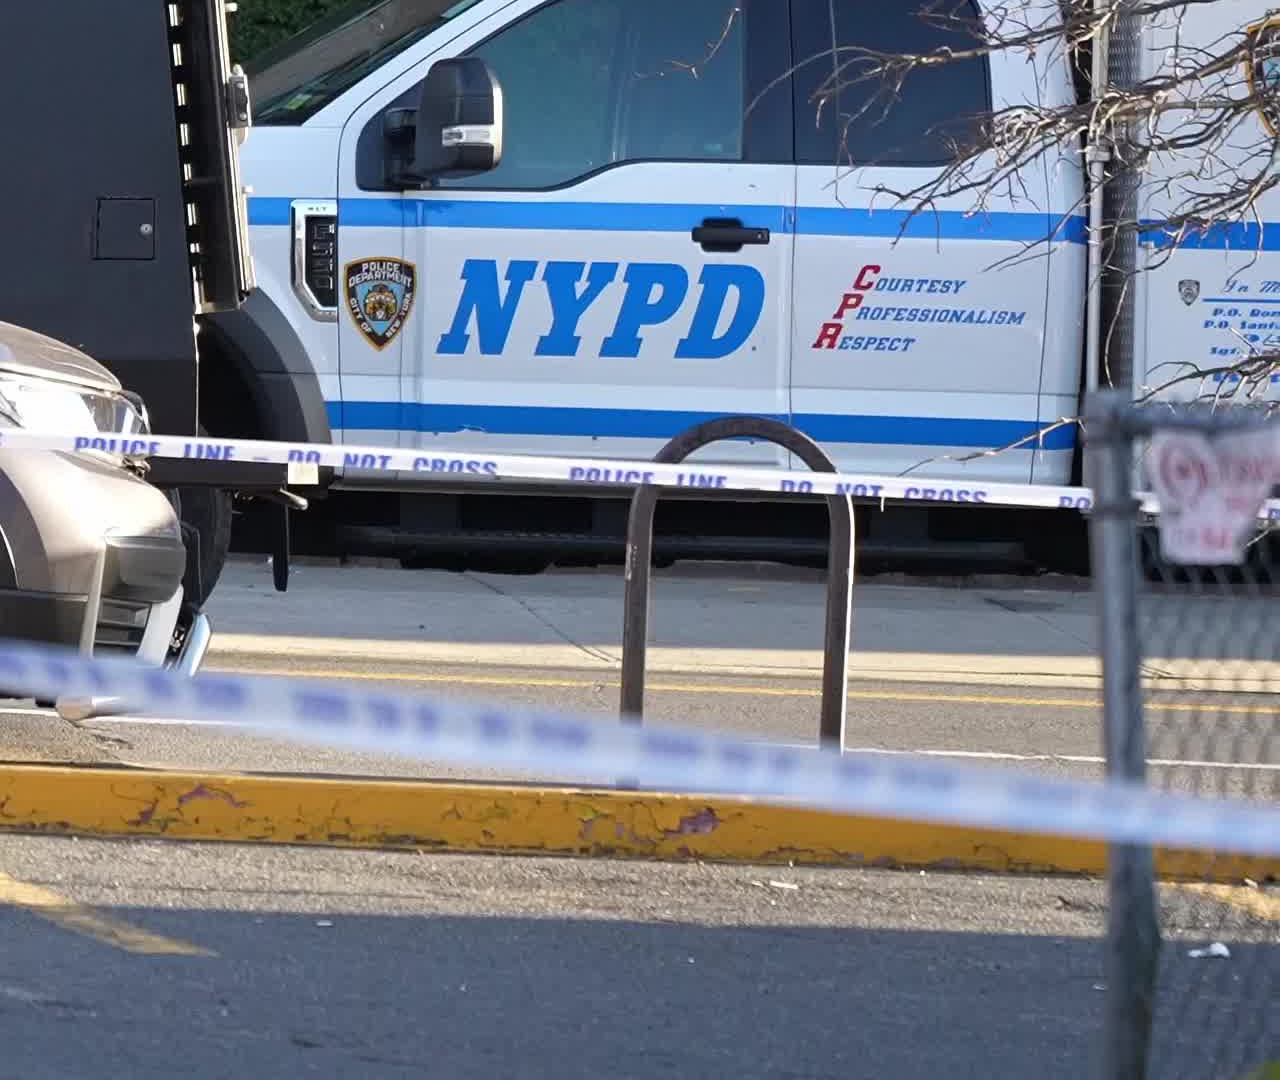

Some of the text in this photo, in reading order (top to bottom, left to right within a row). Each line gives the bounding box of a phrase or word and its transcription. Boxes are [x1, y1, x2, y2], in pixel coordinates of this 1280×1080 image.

[362, 262, 400, 274] POLICE
[348, 270, 412, 288] DEPARTMENT
[350, 297, 372, 333] CITY OF
[436, 259, 765, 359] NYPD
[1204, 320, 1229, 329] P.O
[74, 437, 161, 457] POLICE
[184, 443, 236, 461] LINE
[288, 449, 321, 464] DO
[343, 453, 393, 471] NOT
[413, 457, 499, 475] CROSS
[569, 466, 655, 485] POLICE
